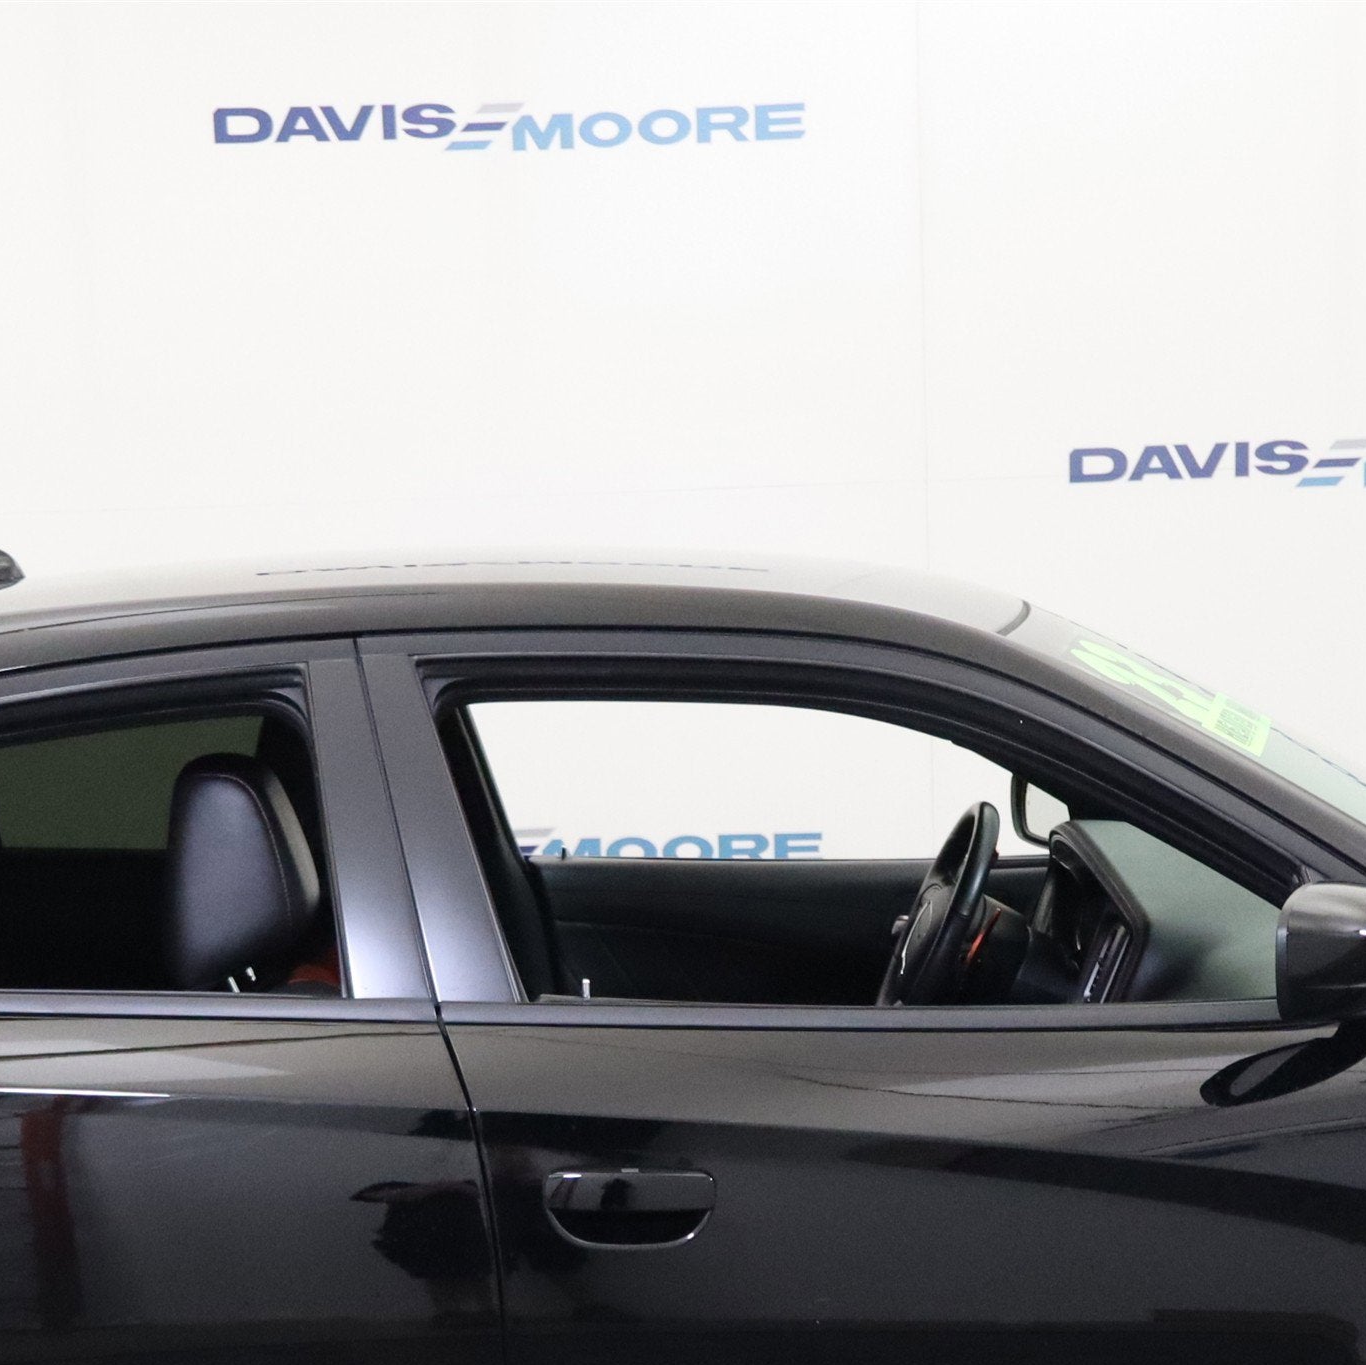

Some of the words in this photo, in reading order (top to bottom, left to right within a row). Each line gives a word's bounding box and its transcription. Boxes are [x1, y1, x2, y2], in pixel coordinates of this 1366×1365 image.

[213, 103, 457, 145] DAVIS
[510, 102, 806, 153] MOORE
[1068, 439, 1309, 484] DAVIS
[541, 831, 824, 860] MOORE
